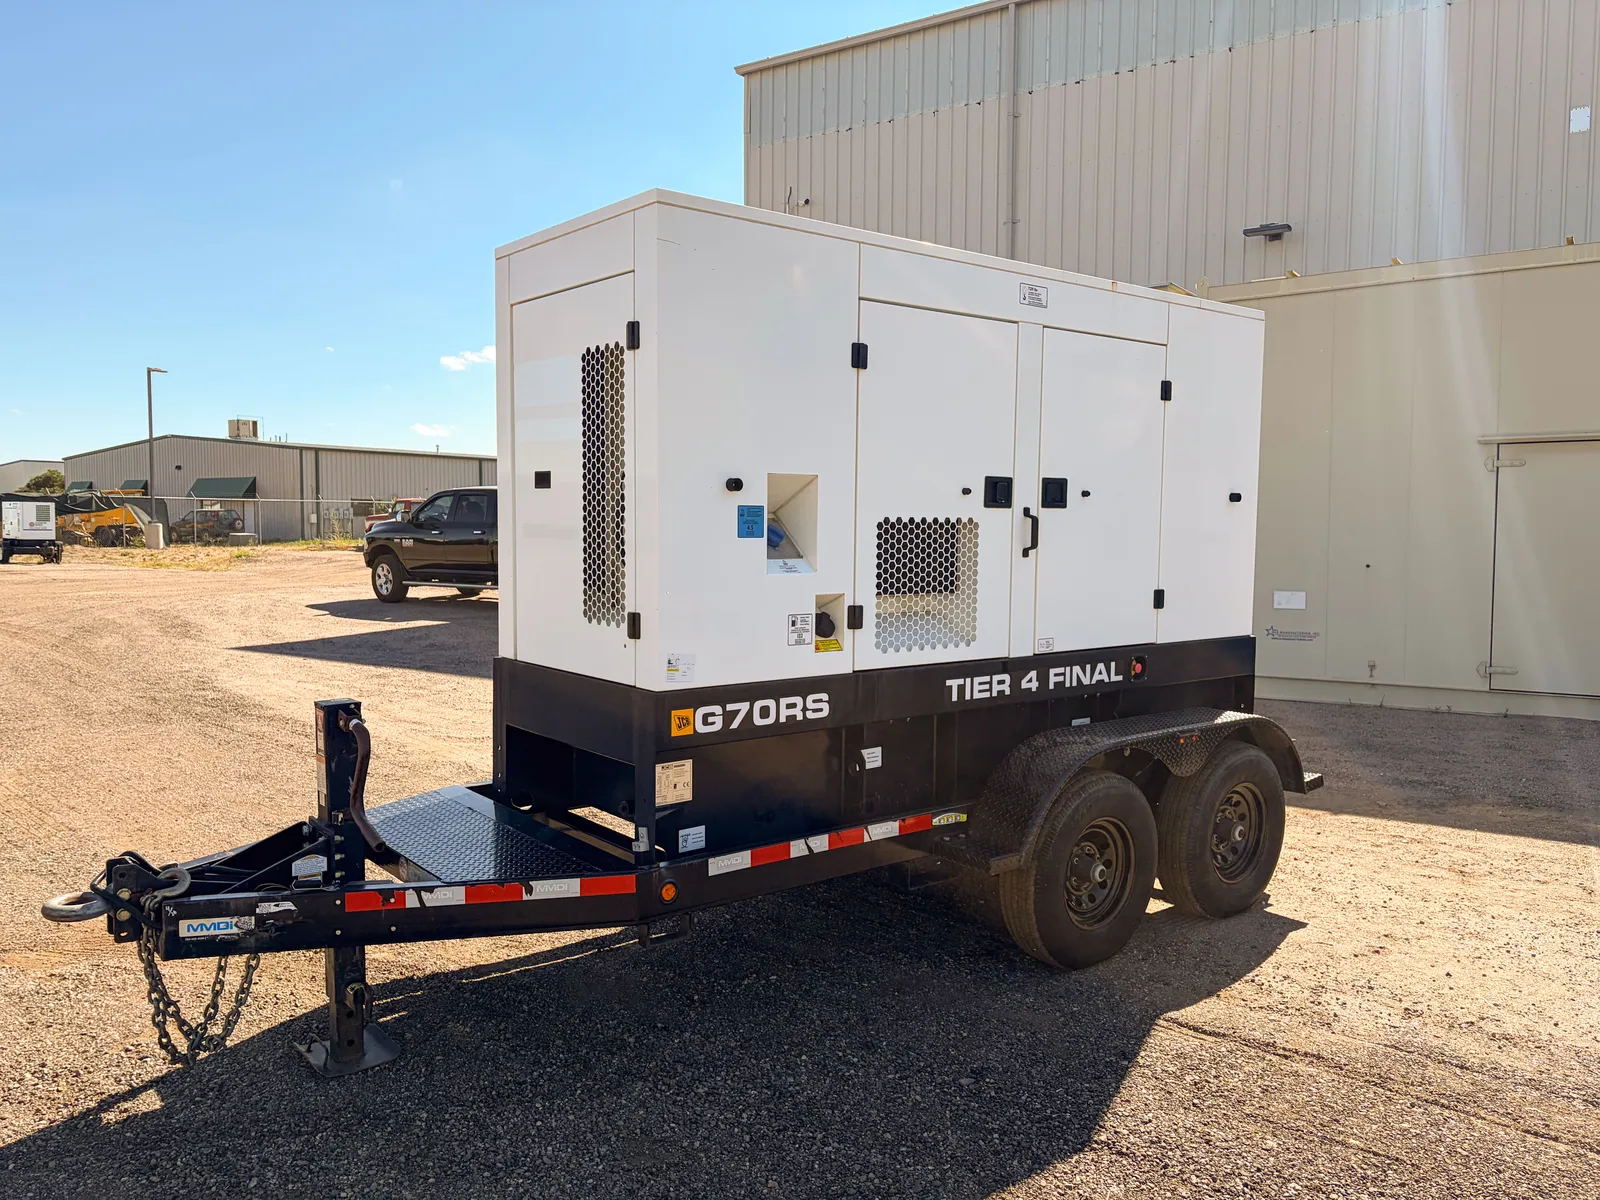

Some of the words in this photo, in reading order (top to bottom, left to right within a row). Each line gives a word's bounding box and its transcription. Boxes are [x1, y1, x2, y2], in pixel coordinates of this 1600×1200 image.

[946, 673, 1011, 702] TIER
[1021, 670, 1039, 692] 4
[1049, 661, 1124, 690] FINAL
[695, 692, 830, 734] G70RS
